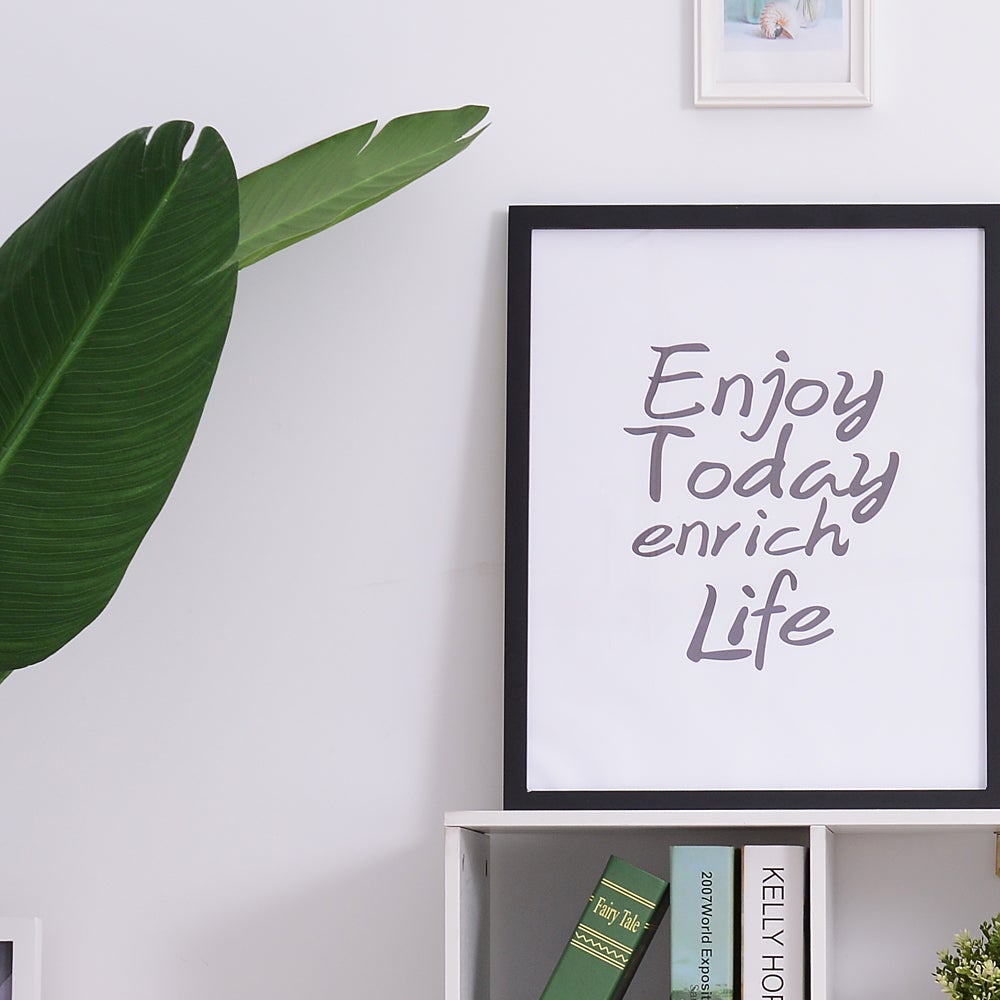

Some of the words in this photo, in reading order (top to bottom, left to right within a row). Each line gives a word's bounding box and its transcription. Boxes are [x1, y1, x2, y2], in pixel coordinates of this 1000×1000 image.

[643, 342, 885, 442] Enjoy
[623, 422, 900, 524] Today
[631, 496, 850, 558] enrich
[686, 568, 835, 671] Life
[593, 896, 621, 926] Fairy
[619, 909, 641, 933] Tale
[700, 871, 713, 944] 2007World
[761, 866, 785, 947] KELLY
